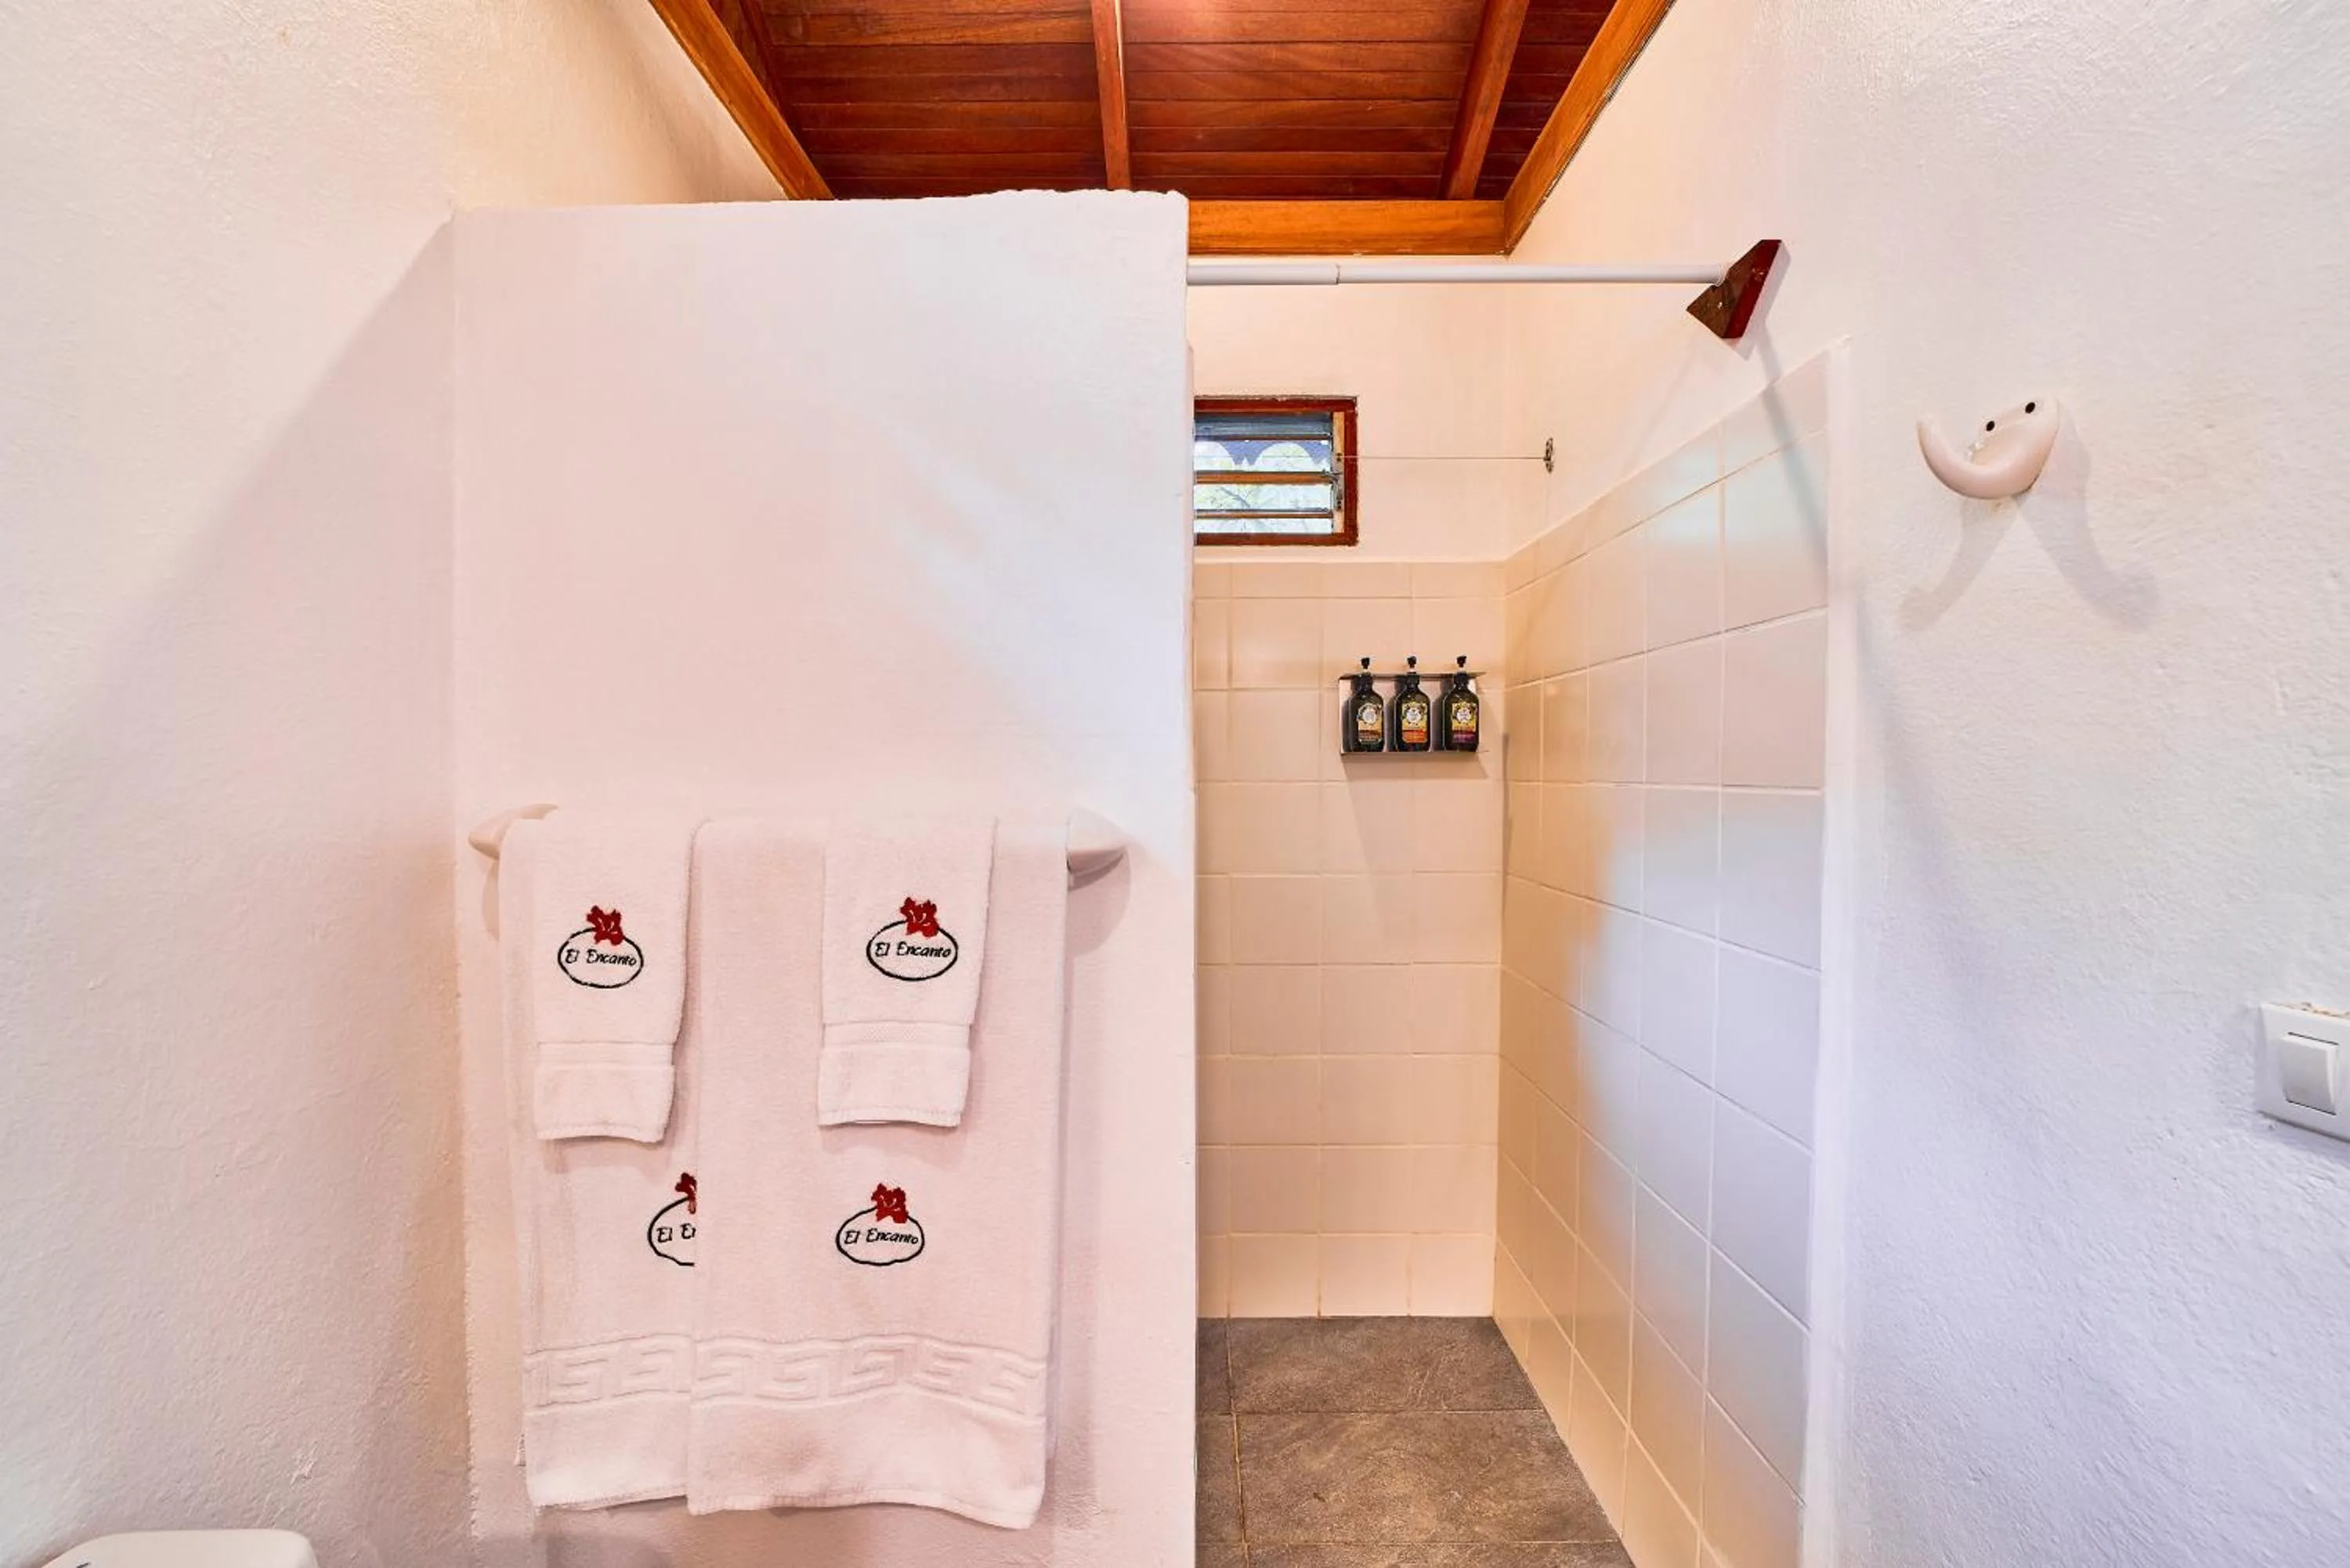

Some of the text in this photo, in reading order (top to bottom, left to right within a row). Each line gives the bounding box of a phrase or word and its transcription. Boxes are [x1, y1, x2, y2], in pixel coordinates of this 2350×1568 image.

[565, 948, 637, 966] El Encanto
[875, 941, 952, 957] El Encanto
[656, 1227, 672, 1243] El
[844, 1227, 919, 1244] El Encanto
